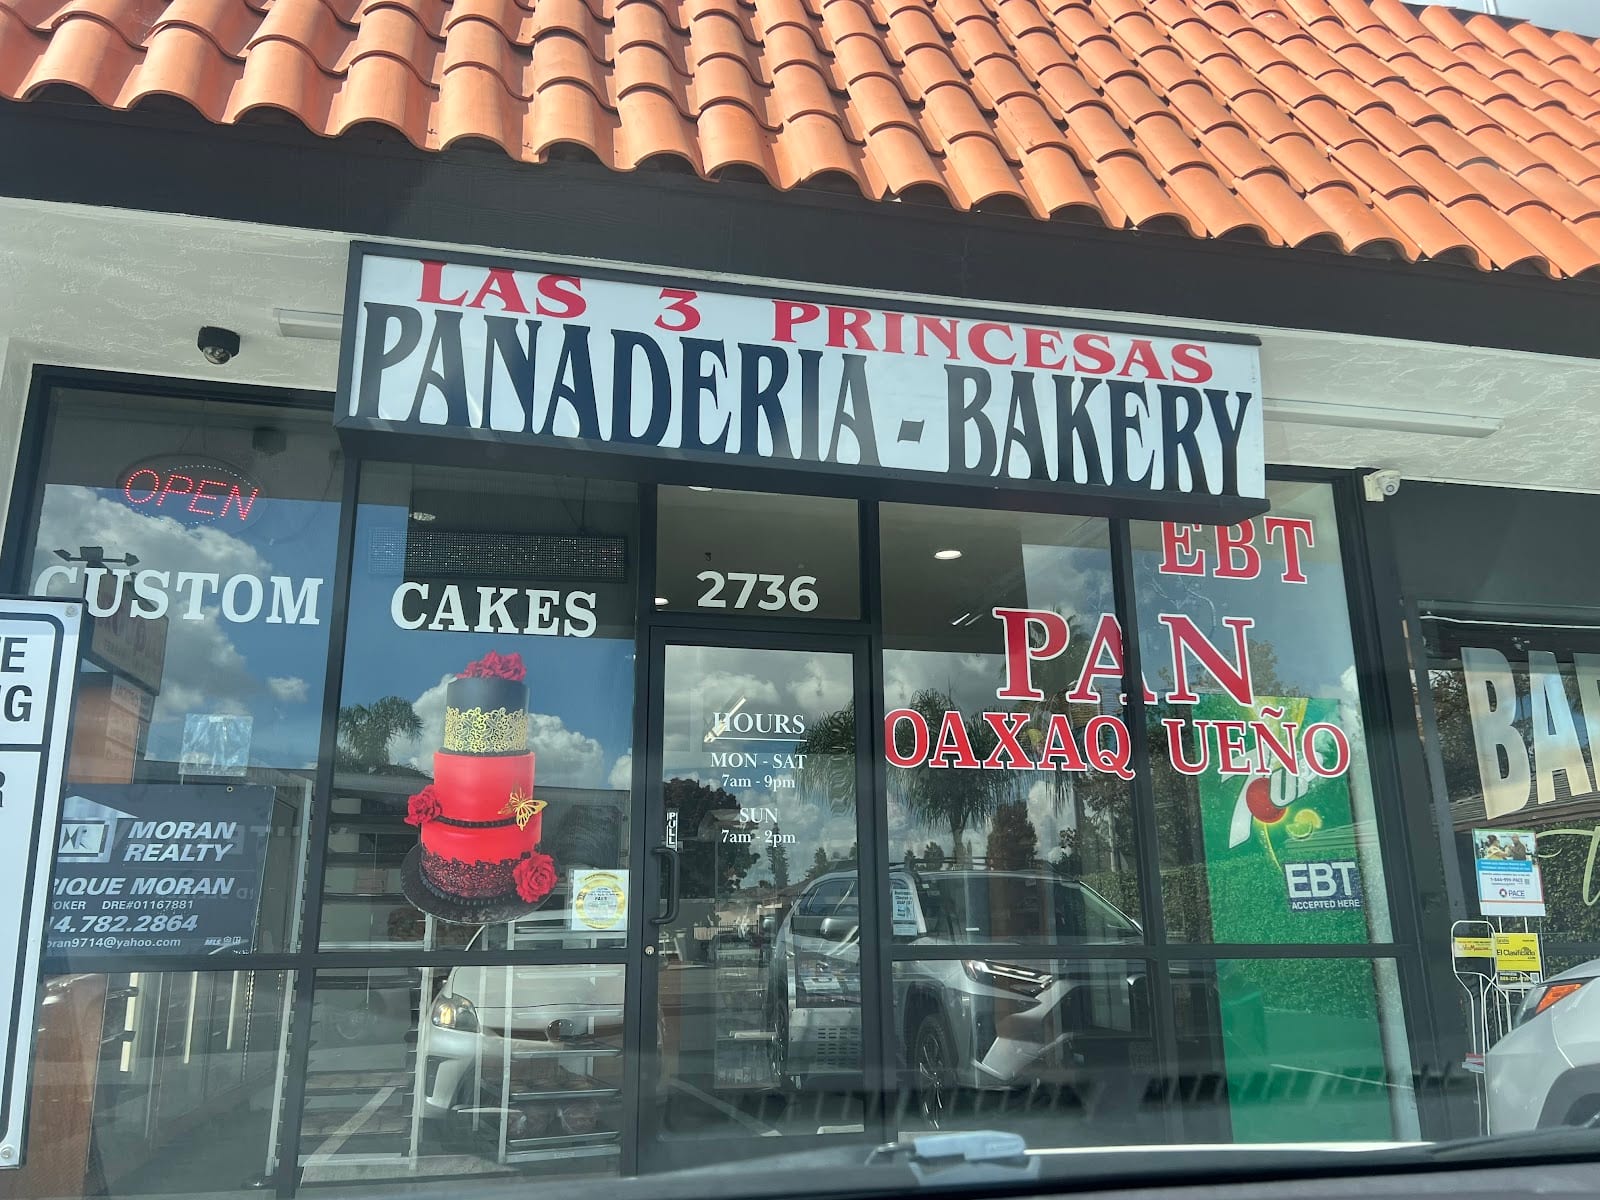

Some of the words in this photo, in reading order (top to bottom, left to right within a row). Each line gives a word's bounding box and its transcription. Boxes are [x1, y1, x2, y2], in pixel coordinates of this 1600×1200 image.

[416, 260, 588, 318] LAS
[653, 288, 701, 332] 3
[771, 299, 1214, 384] PRINCESAS
[355, 301, 882, 467] PANADERIA
[897, 418, 925, 444] -
[943, 363, 1252, 497] BAKERY
[123, 468, 260, 522] OPEN
[1159, 516, 1315, 585] EBT
[33, 564, 324, 627] CUSTOM
[696, 570, 820, 612] 2736
[390, 581, 599, 639] CAKES
[0, 637, 28, 673] E
[992, 606, 1256, 707] PAN
[0, 684, 33, 722] G
[711, 712, 806, 735] HOURS
[711, 752, 758, 769] MON
[772, 754, 808, 770] SAT
[721, 774, 751, 788] 7am
[764, 775, 796, 791] 9pm
[667, 812, 677, 846] PULL
[739, 807, 779, 824] SUN
[127, 821, 238, 840] MORAN
[721, 829, 751, 844] 7am
[764, 830, 796, 848] 2pm
[123, 844, 234, 862] REALTY
[129, 877, 236, 896] MORAN
[1284, 861, 1356, 899] EBT
[1508, 889, 1526, 897] PACE
[53, 900, 87, 910] OKER
[101, 900, 194, 911] DRE#01167881
[1291, 899, 1336, 911] ACCEPTED
[1337, 898, 1361, 909] HERE
[1503, 947, 1536, 956] Clasificado
